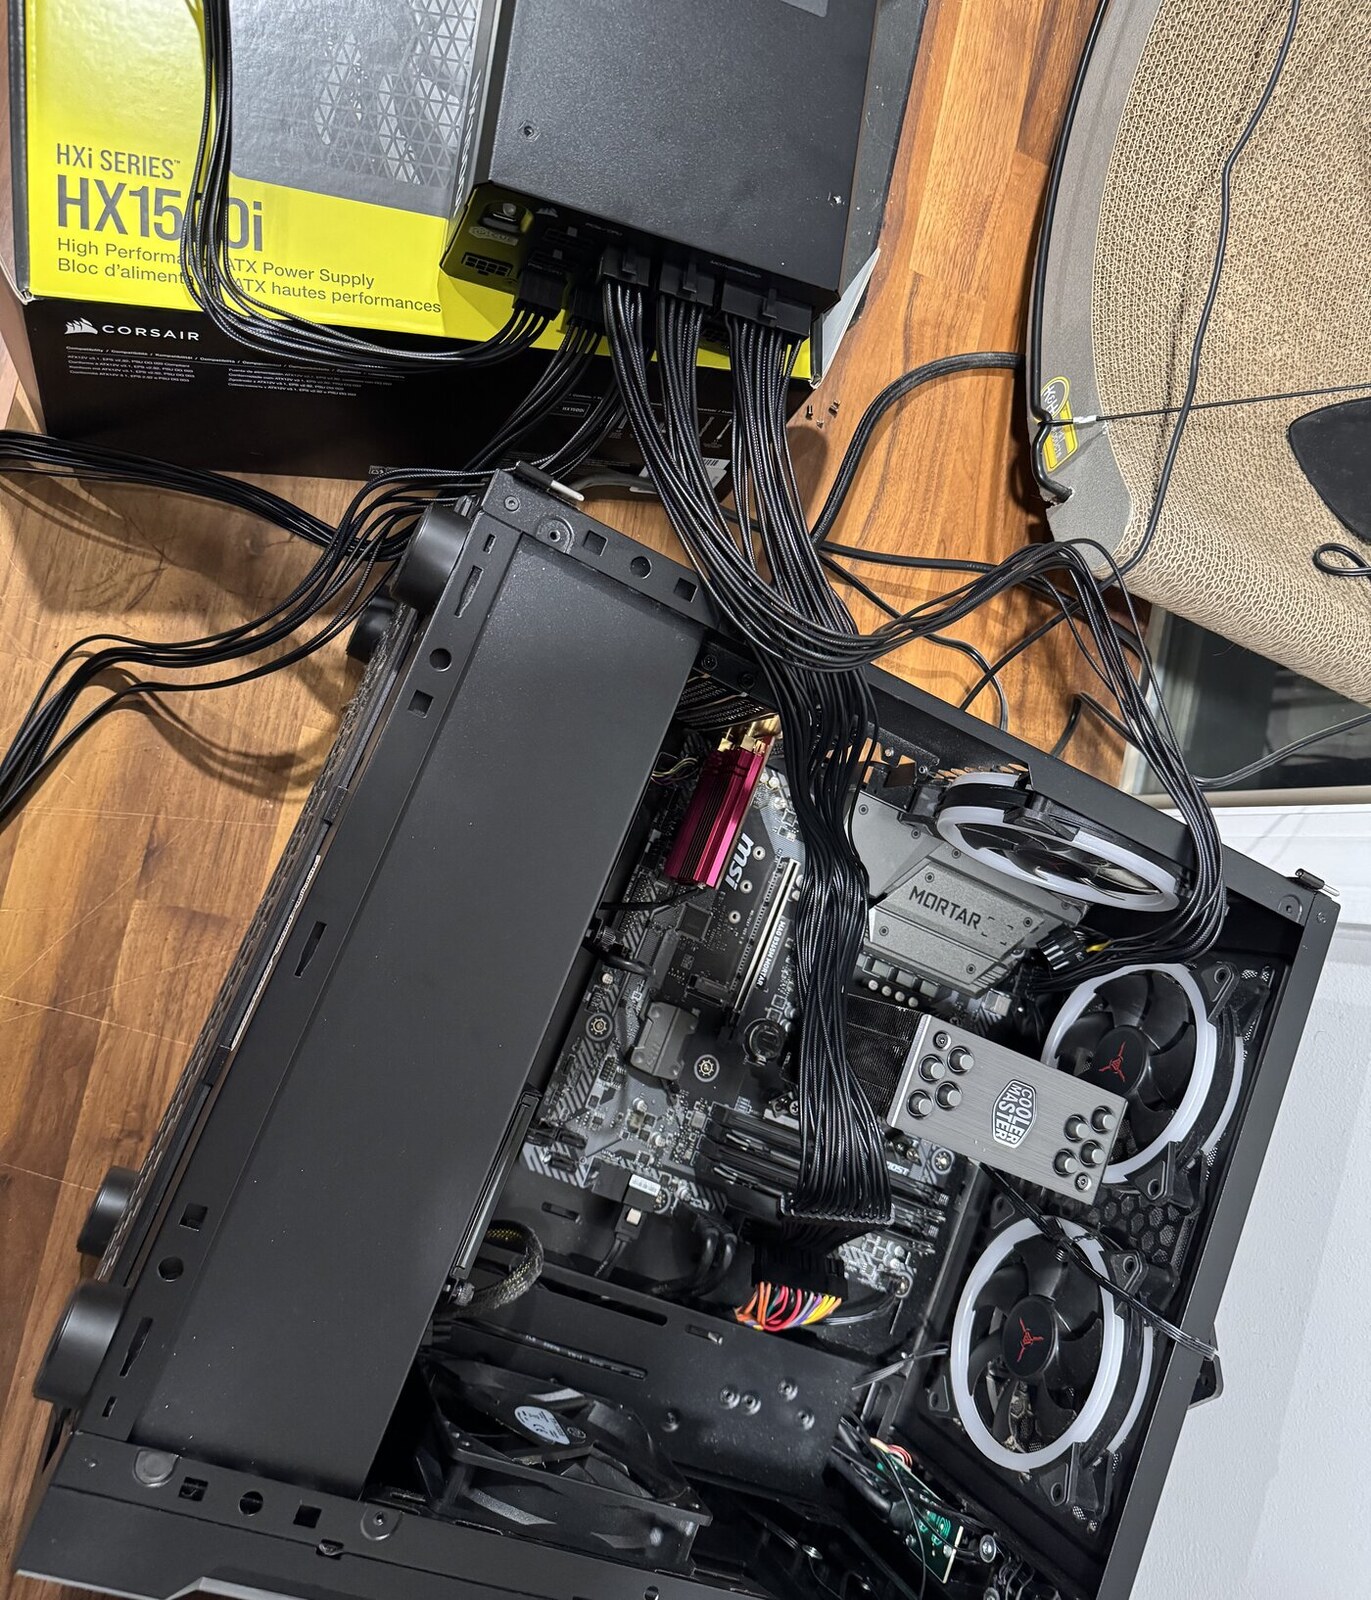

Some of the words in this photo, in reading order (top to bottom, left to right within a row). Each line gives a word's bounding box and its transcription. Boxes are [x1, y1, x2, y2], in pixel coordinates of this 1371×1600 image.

[56, 143, 93, 171] HXi
[57, 174, 263, 252] HX150i
[57, 238, 99, 257] High
[105, 243, 214, 270] Performa
[262, 262, 315, 280] Power
[319, 268, 375, 288] Supply
[58, 258, 99, 275] Bloc
[270, 281, 326, 301] hautes
[332, 291, 442, 313] performances
[102, 324, 199, 341] CORSAIR
[725, 833, 754, 890] msi
[909, 886, 981, 929] MORTAR
[996, 1084, 1022, 1139] MASTER
[1007, 1089, 1033, 1144] COOLER
